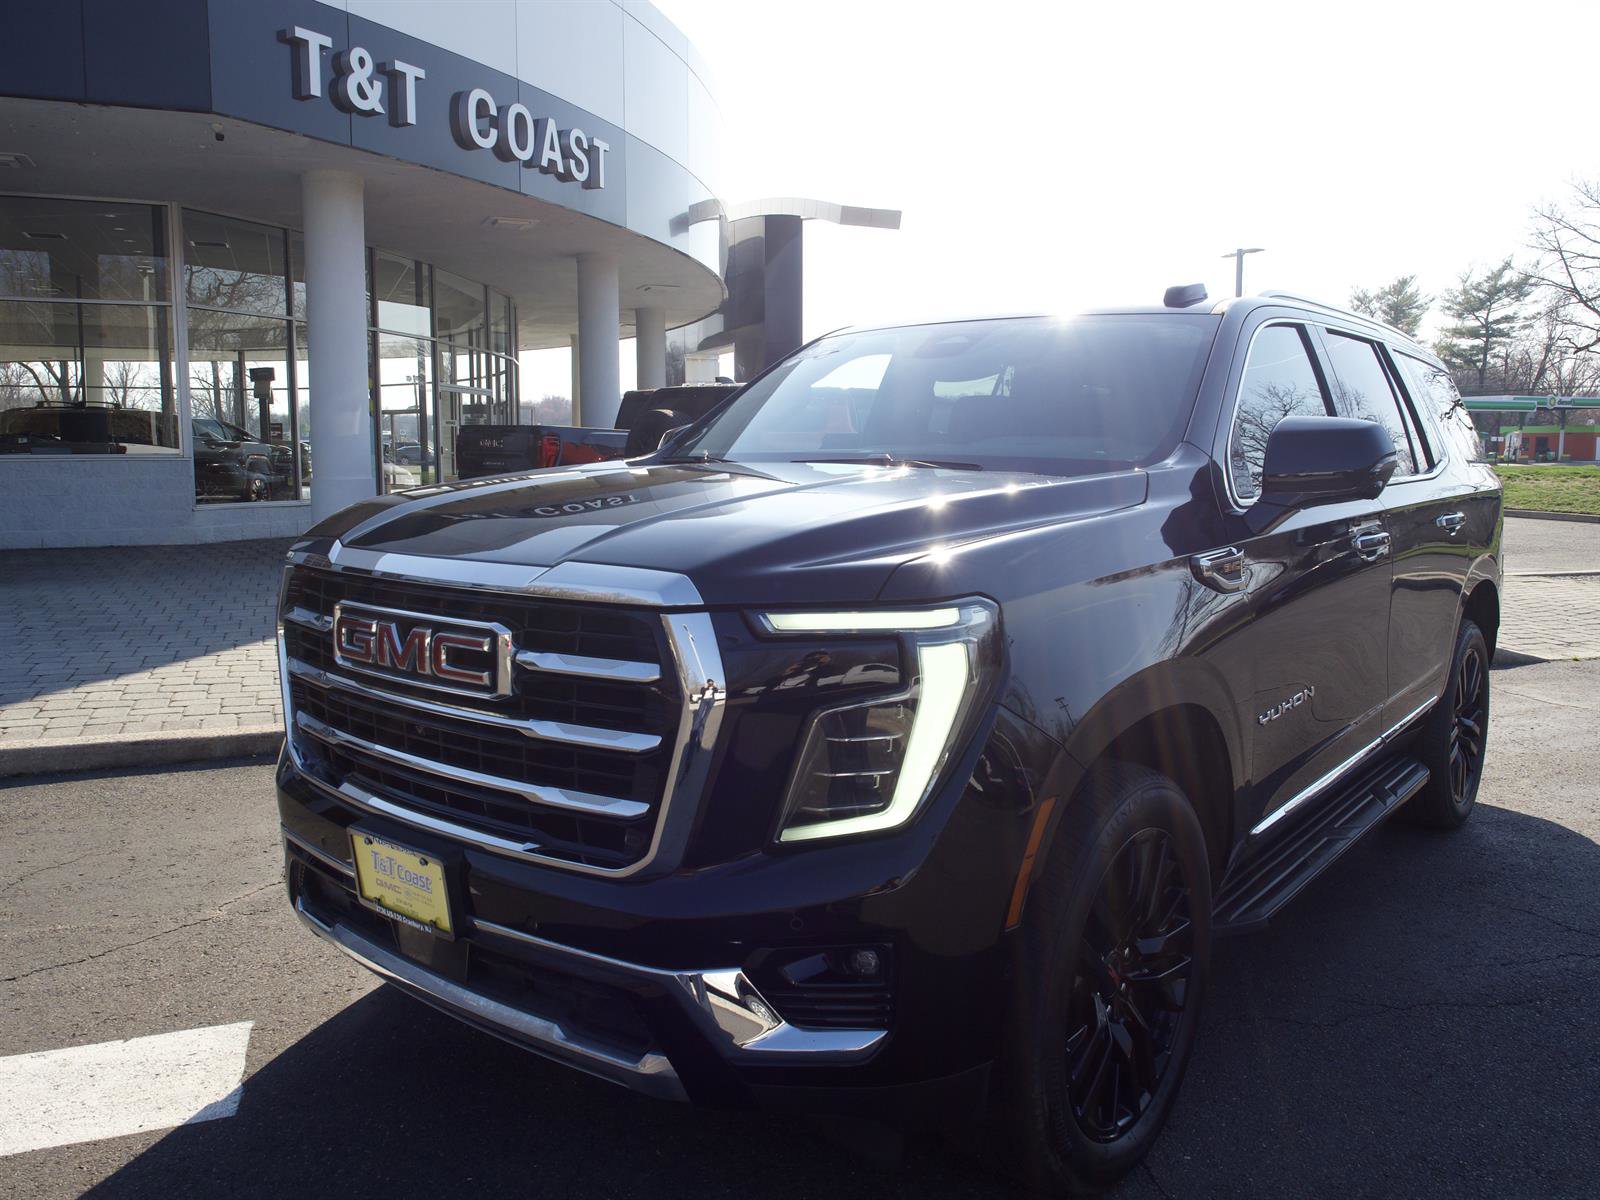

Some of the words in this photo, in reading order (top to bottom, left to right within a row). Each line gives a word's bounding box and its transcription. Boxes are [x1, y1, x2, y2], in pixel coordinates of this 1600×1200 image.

[291, 25, 426, 127] T&T
[464, 87, 610, 189] COAST
[336, 615, 492, 687] GMC
[1259, 685, 1315, 725] YUKON
[371, 850, 396, 879] T&T
[397, 864, 432, 893] Coast
